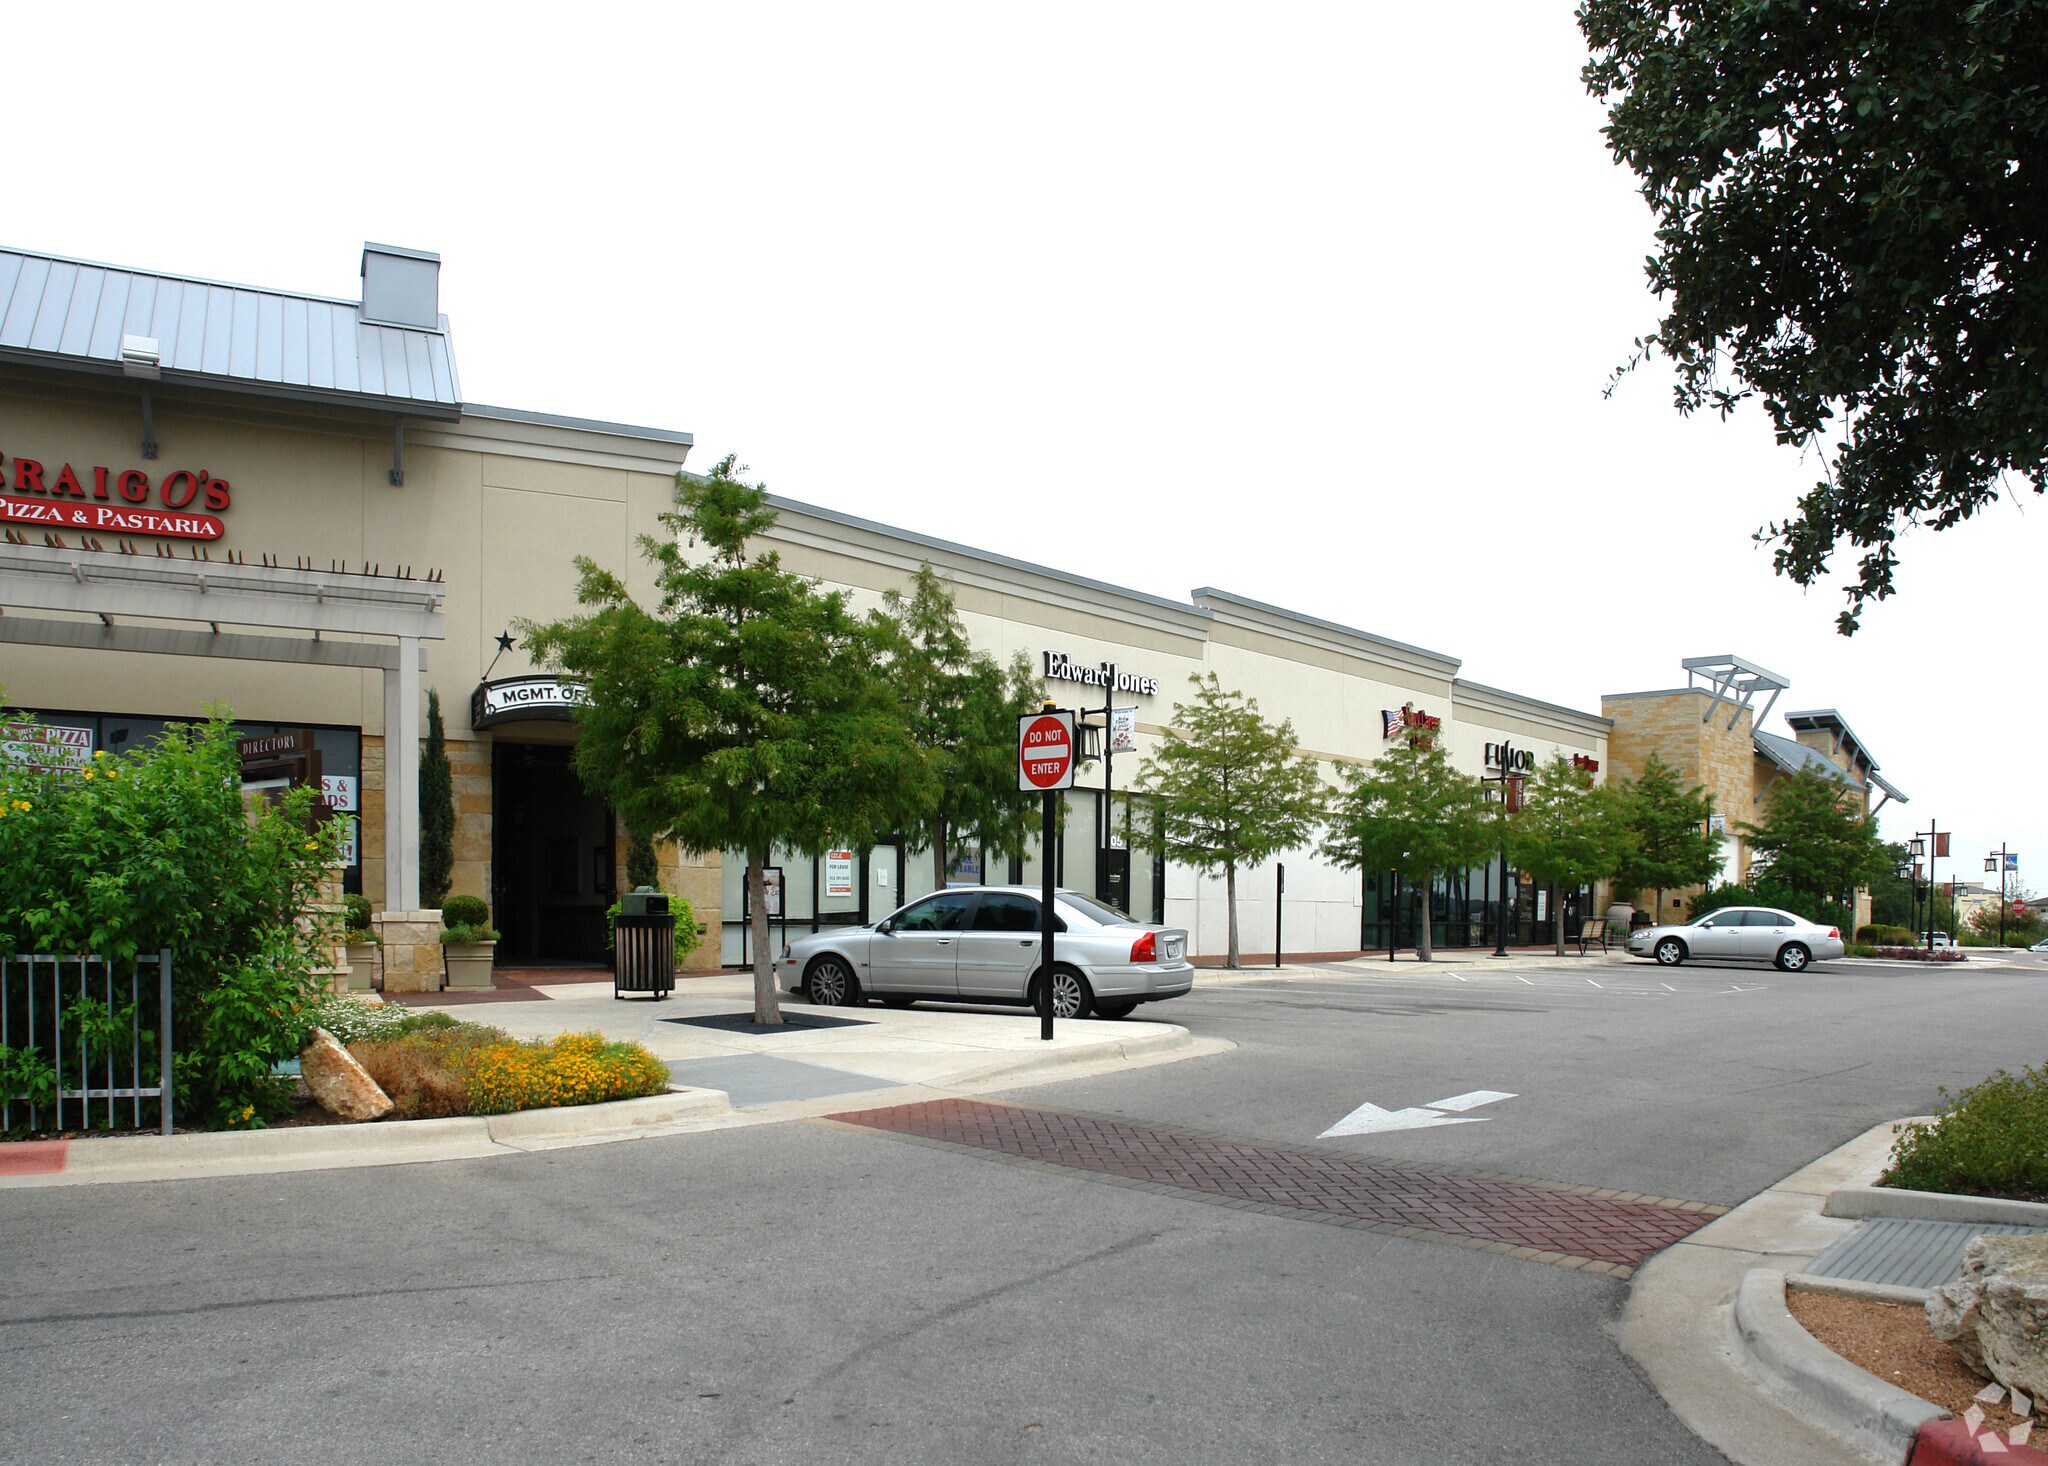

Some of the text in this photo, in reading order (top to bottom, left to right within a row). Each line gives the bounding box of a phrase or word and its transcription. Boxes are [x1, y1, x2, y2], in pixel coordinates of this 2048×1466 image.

[71, 510, 89, 524] &
[96, 508, 217, 535] PASTARIA
[1045, 651, 1160, 696] Edward Jones
[502, 687, 558, 703] MGMT.
[46, 728, 89, 746] PIZZA
[1029, 729, 1063, 743] DO NOT
[242, 735, 295, 755] DIRECTORY
[1031, 762, 1061, 775] ENTER
[336, 779, 348, 792] &
